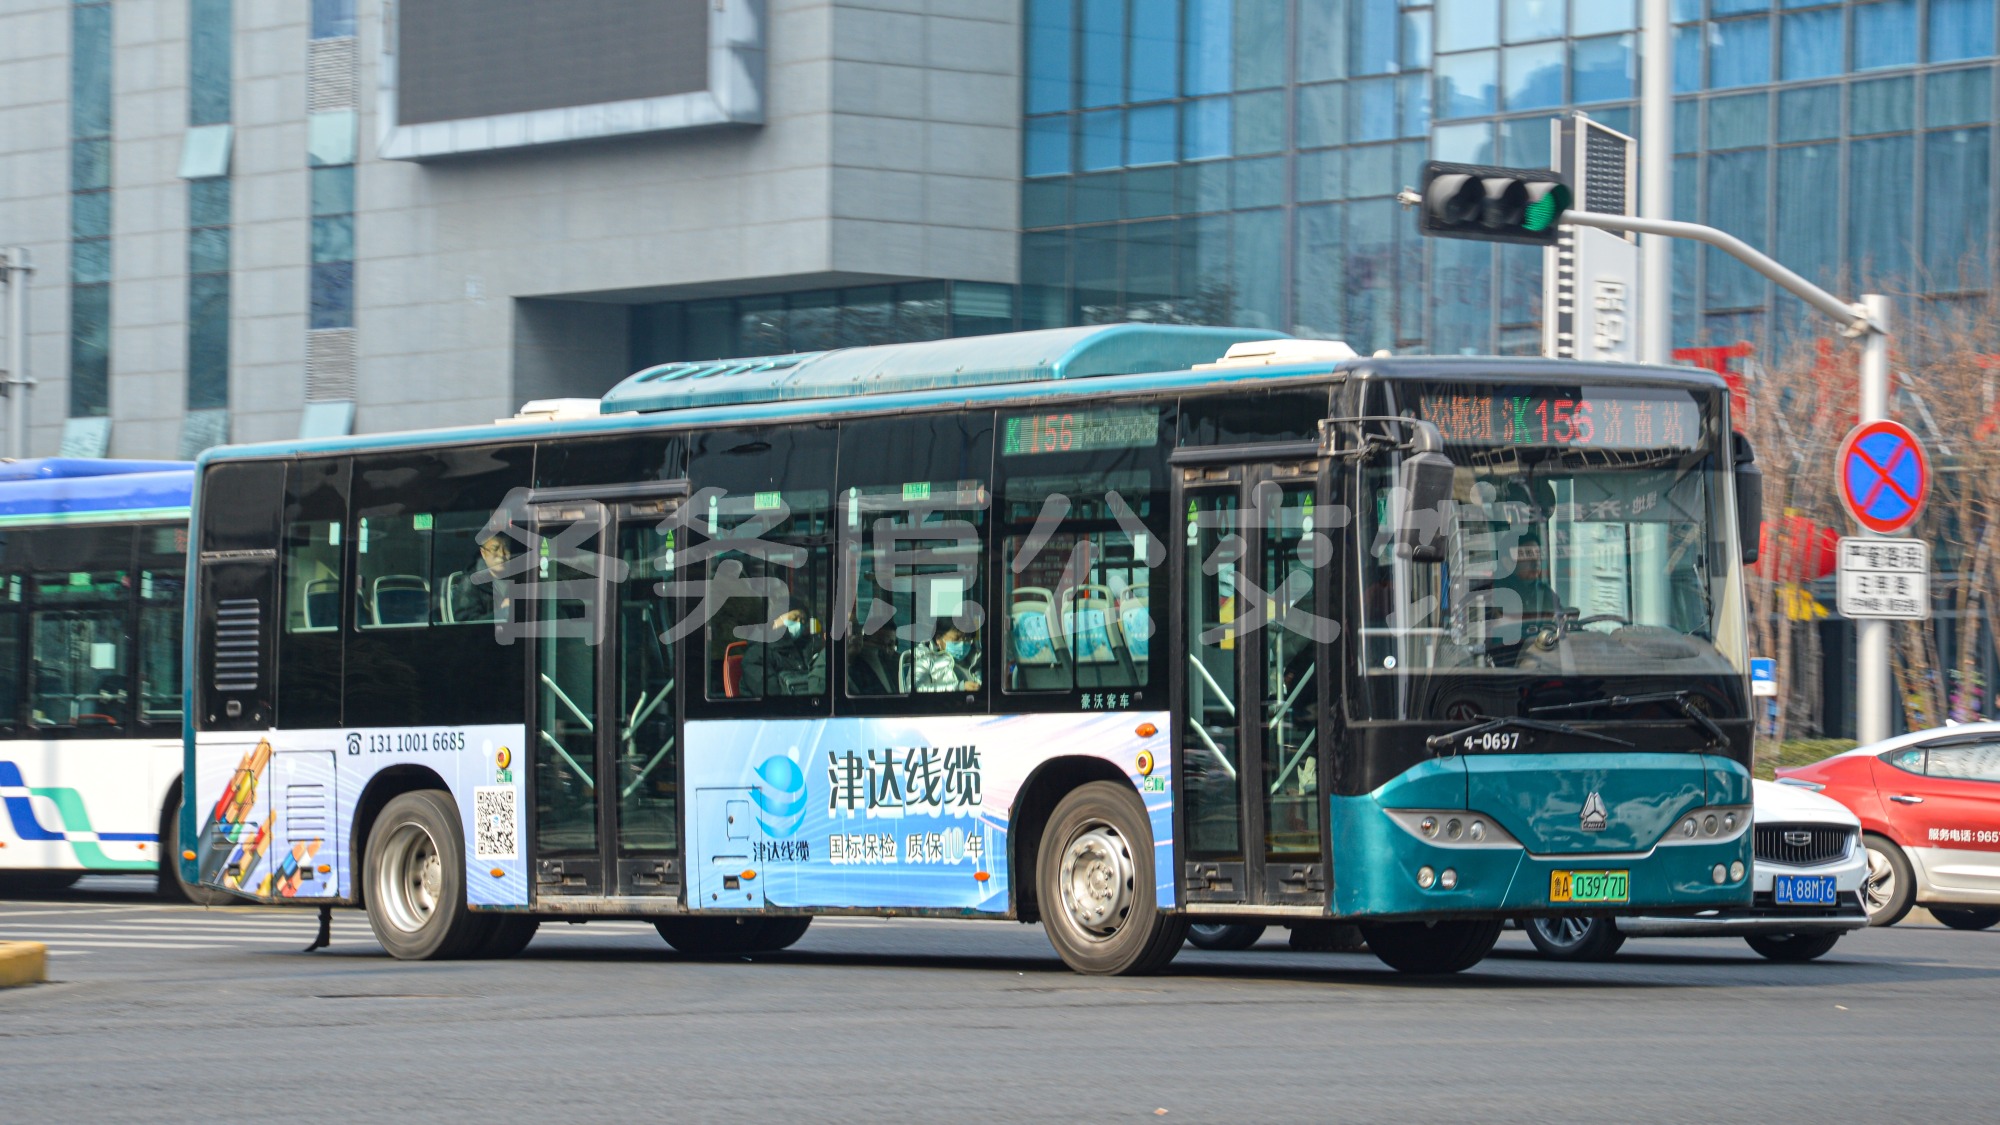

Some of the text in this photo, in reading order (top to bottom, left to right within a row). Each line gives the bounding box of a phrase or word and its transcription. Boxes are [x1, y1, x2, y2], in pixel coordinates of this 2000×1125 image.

[1080, 692, 1130, 709] 豪沃客车
[369, 732, 465, 753] 131 1001 6685
[1464, 733, 1519, 750] 4-0697
[828, 745, 983, 812] 津达线缆
[1928, 827, 2000, 843] 服务电话:965
[753, 840, 810, 862] 津达线缆
[829, 833, 897, 859] 国标保检
